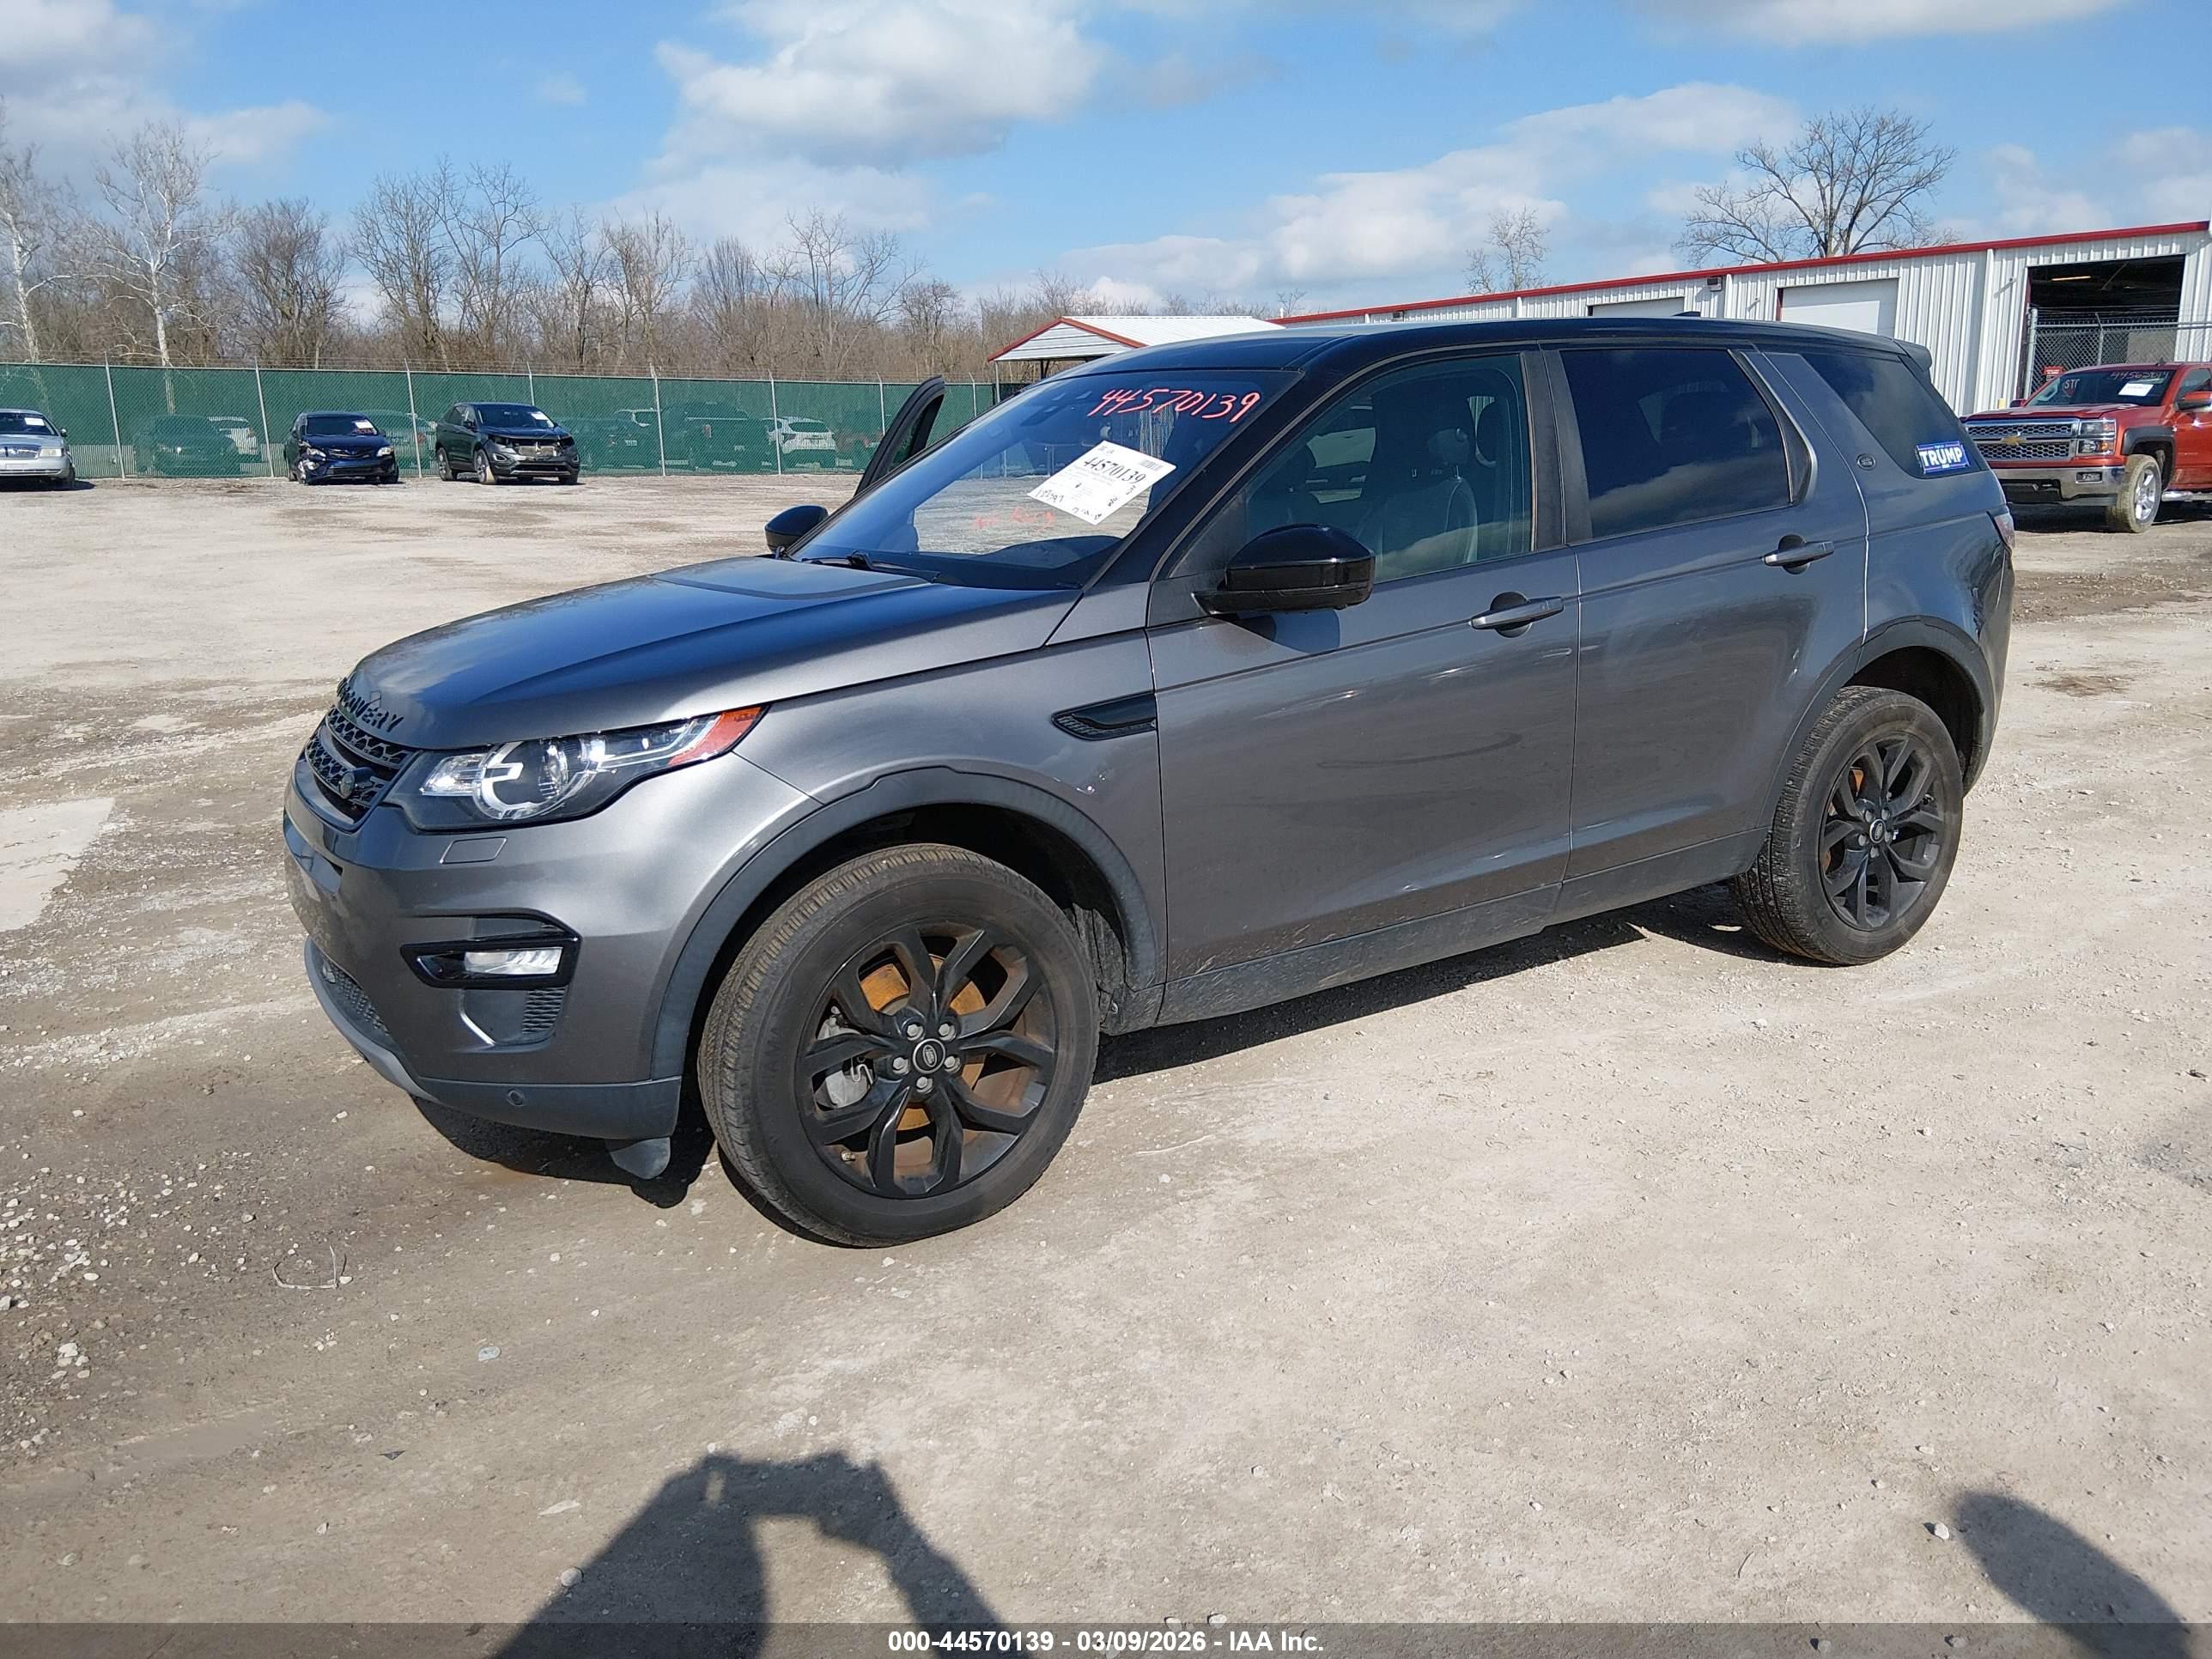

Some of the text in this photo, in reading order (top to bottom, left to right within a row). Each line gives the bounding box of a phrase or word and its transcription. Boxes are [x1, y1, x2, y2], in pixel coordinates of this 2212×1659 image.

[1086, 389, 1261, 423] 44570139
[1083, 456, 1146, 484] 44570139
[1918, 447, 1963, 467] TRUMP
